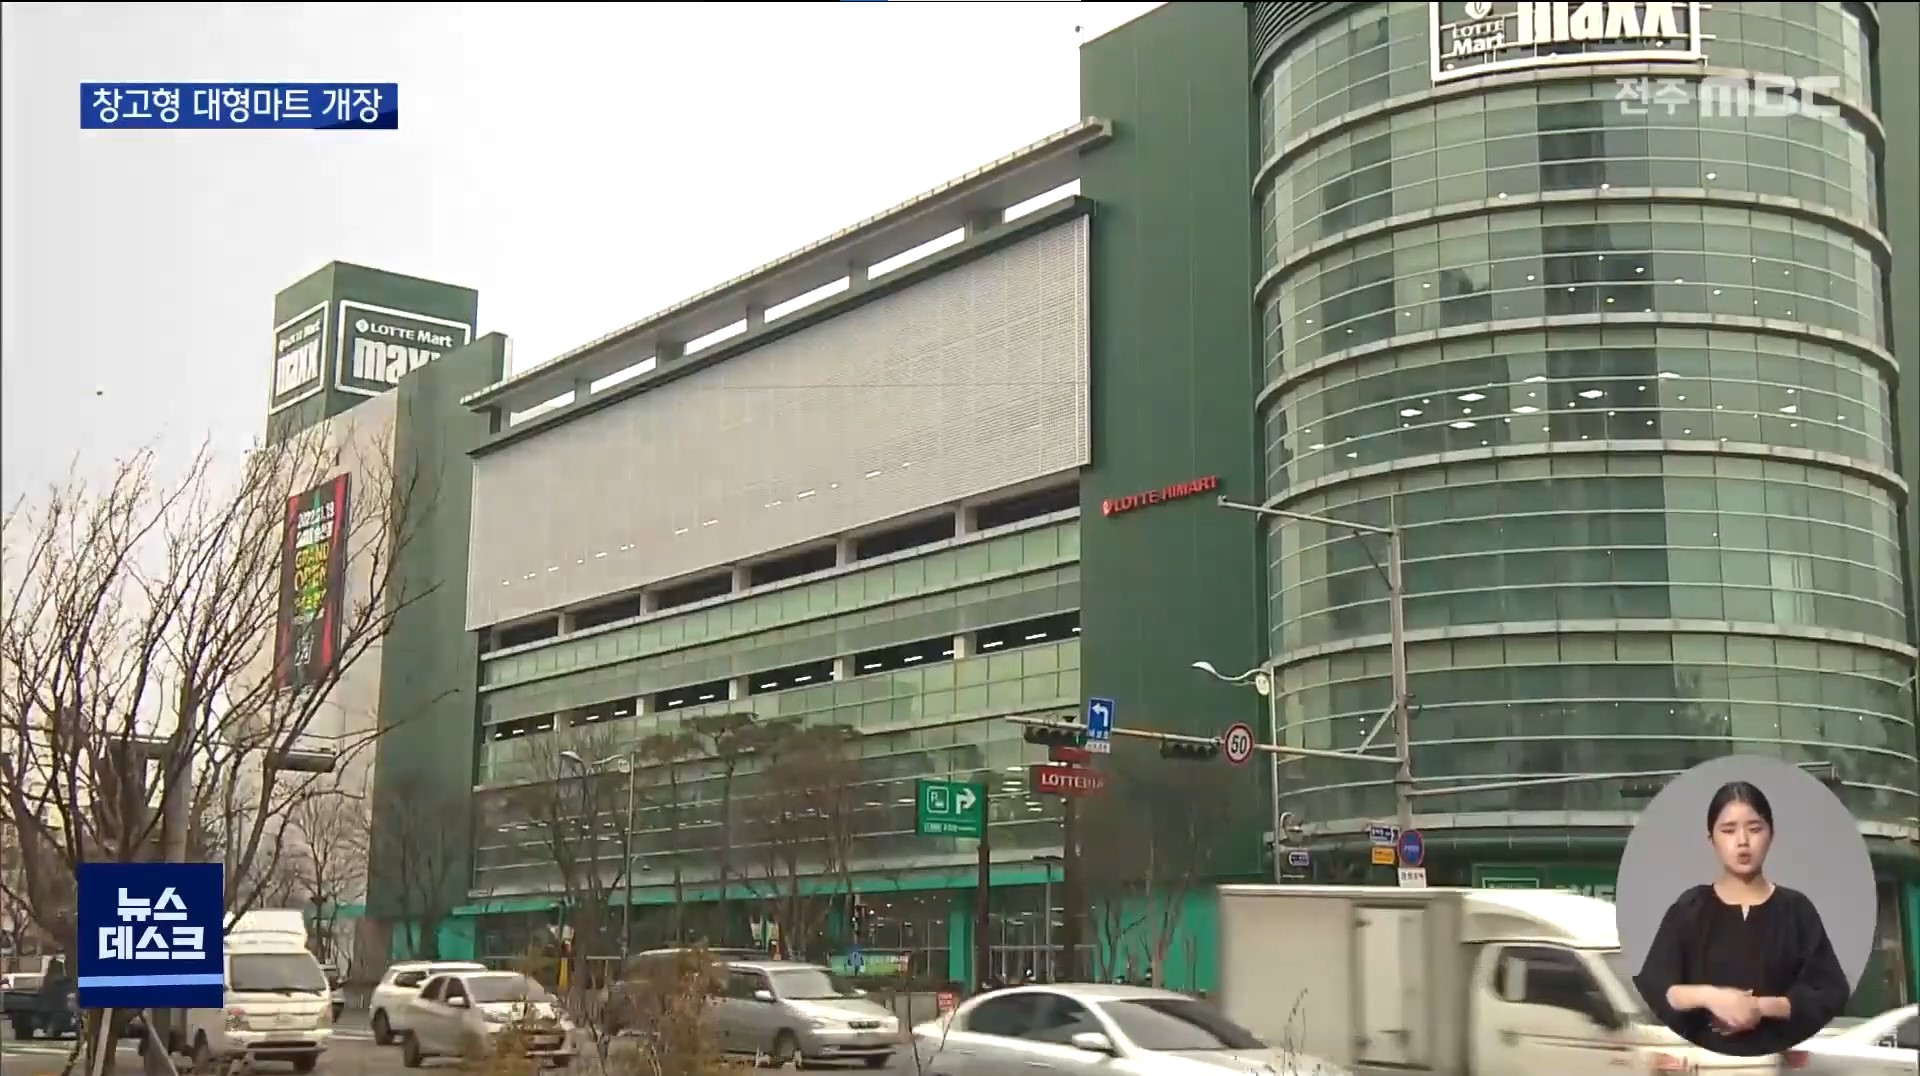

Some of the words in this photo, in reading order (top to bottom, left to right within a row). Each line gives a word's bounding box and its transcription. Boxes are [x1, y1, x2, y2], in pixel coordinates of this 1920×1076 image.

[1452, 19, 1504, 39] LOTTE
[1452, 32, 1504, 56] Mart
[370, 323, 415, 340] LOTTE
[417, 330, 453, 348] Mart
[1114, 490, 1160, 512] LOTTE
[1162, 475, 1217, 501] HIMART
[1231, 735, 1247, 754] 50
